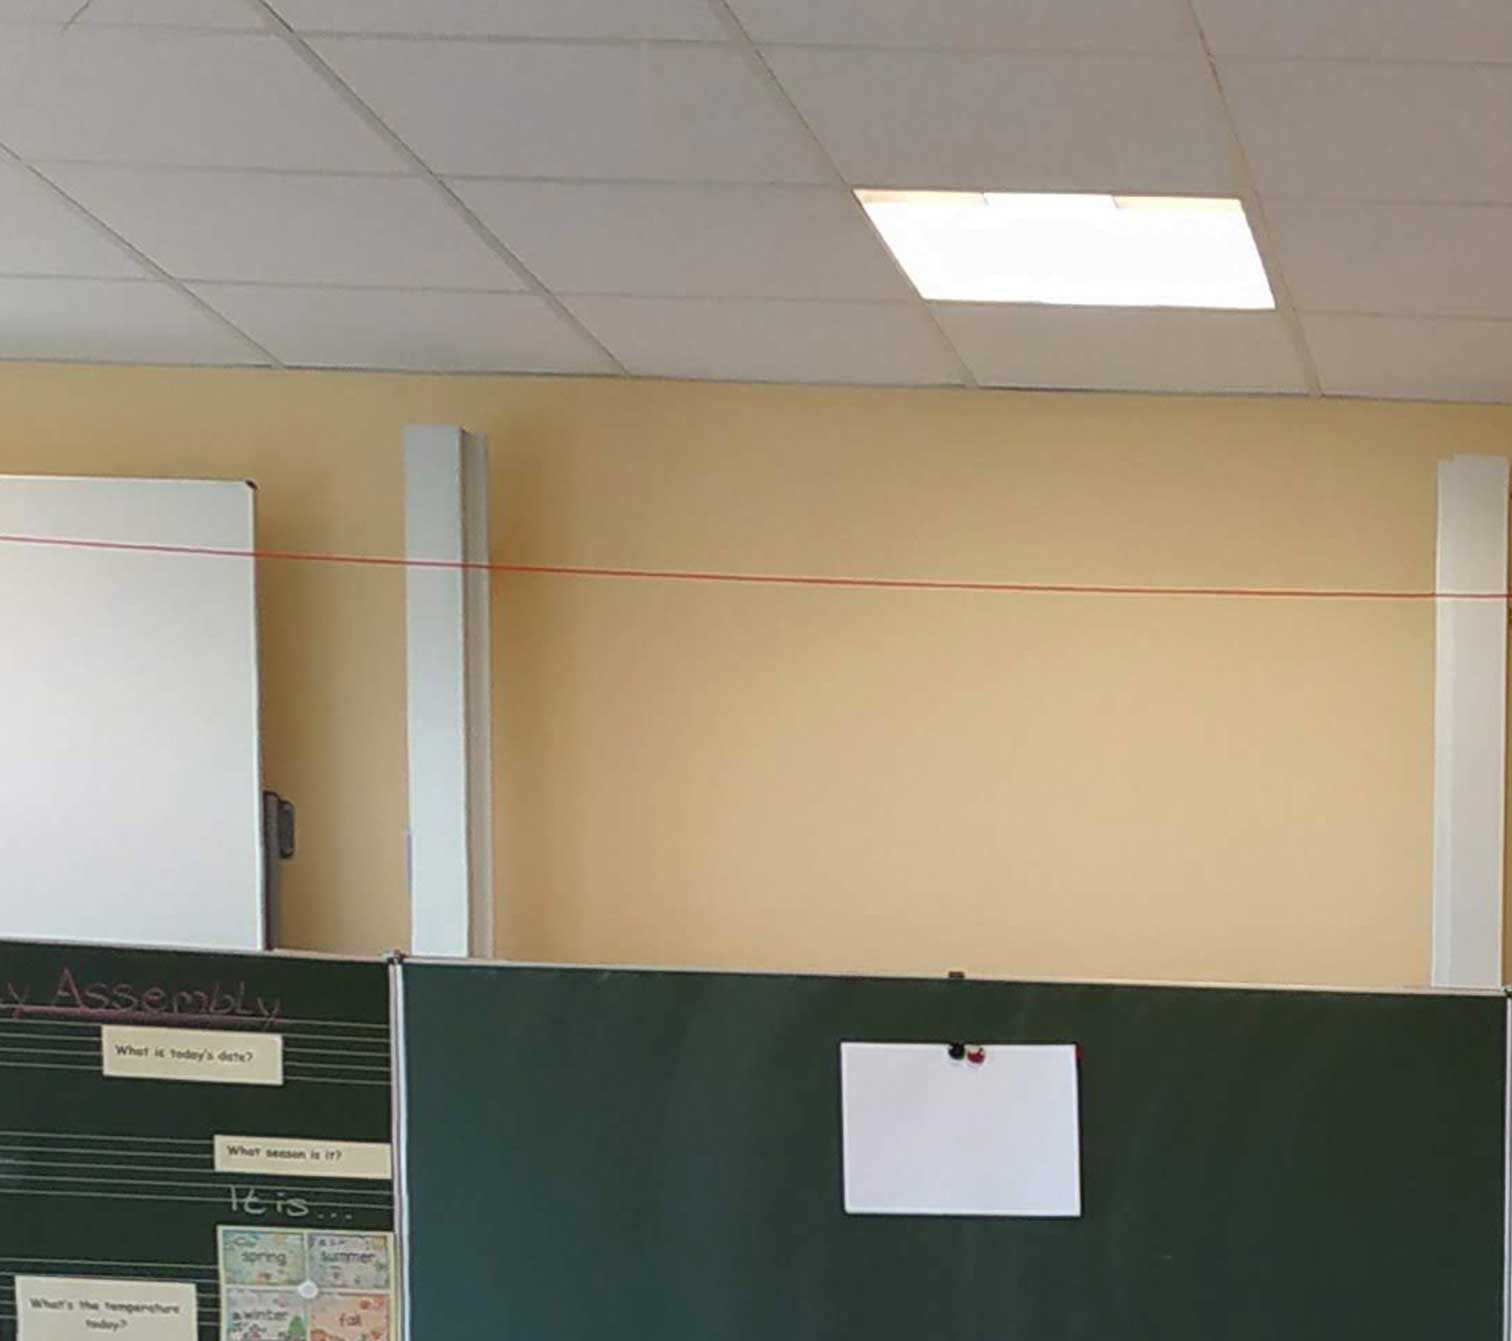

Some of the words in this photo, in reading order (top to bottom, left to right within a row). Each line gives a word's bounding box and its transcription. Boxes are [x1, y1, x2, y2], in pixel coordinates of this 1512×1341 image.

[51, 967, 282, 1030] Assembly
[115, 1043, 149, 1058] What
[155, 1046, 164, 1058] is
[170, 1047, 213, 1062] today's
[218, 1049, 253, 1063] date?
[227, 1145, 260, 1158] What
[266, 1149, 305, 1161] season
[311, 1149, 320, 1160] is
[324, 1149, 342, 1162] it?
[229, 1185, 266, 1215] It
[241, 1251, 287, 1269] spring
[321, 1250, 375, 1264] summer
[30, 1296, 75, 1312] What's
[80, 1300, 99, 1312] the
[105, 1301, 180, 1316] temperature
[246, 1308, 290, 1322] winter
[339, 1313, 361, 1327] fall
[86, 1317, 127, 1332] today?
